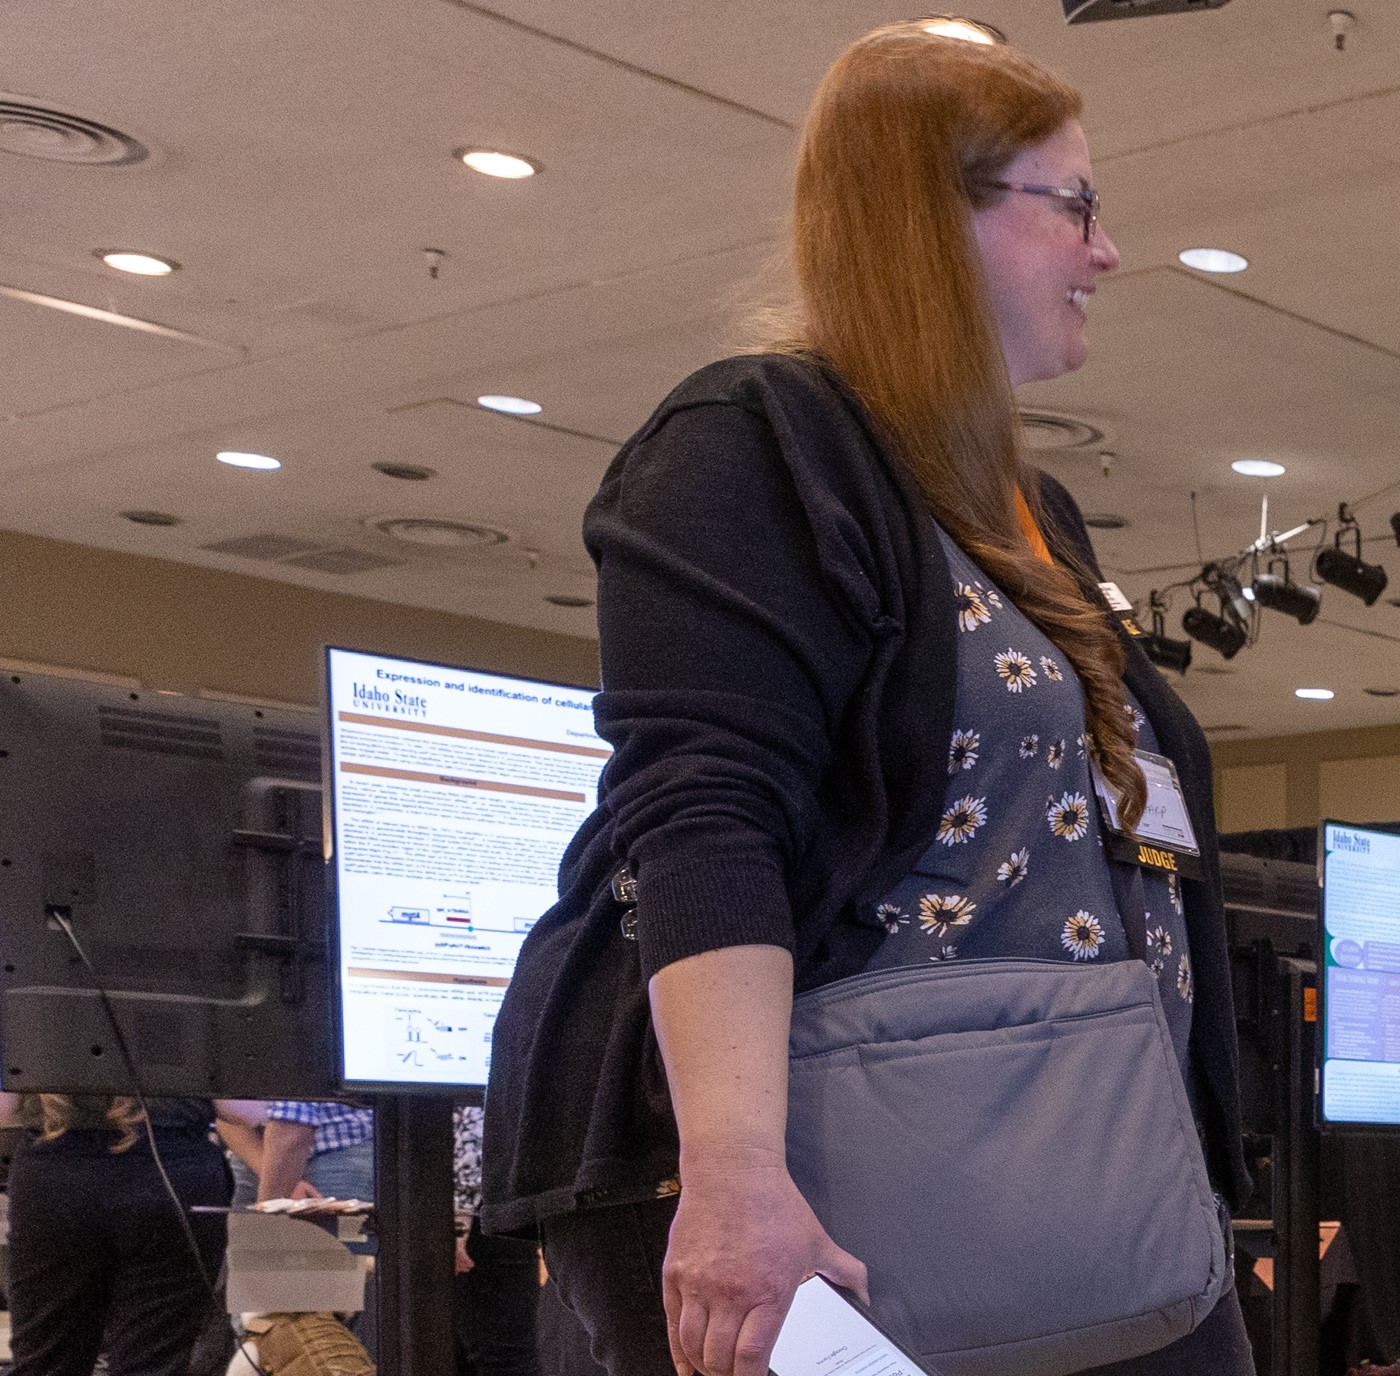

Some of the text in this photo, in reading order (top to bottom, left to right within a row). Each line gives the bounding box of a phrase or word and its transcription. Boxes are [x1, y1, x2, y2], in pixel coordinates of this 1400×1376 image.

[352, 682, 428, 709] Idaho State
[376, 669, 441, 688] Expression
[444, 681, 465, 692] and
[468, 684, 539, 702] identification
[541, 695, 553, 705] of
[353, 700, 428, 718] UNIVERSITY
[1333, 829, 1370, 847] Idaho State
[1138, 845, 1178, 871] JUDGE
